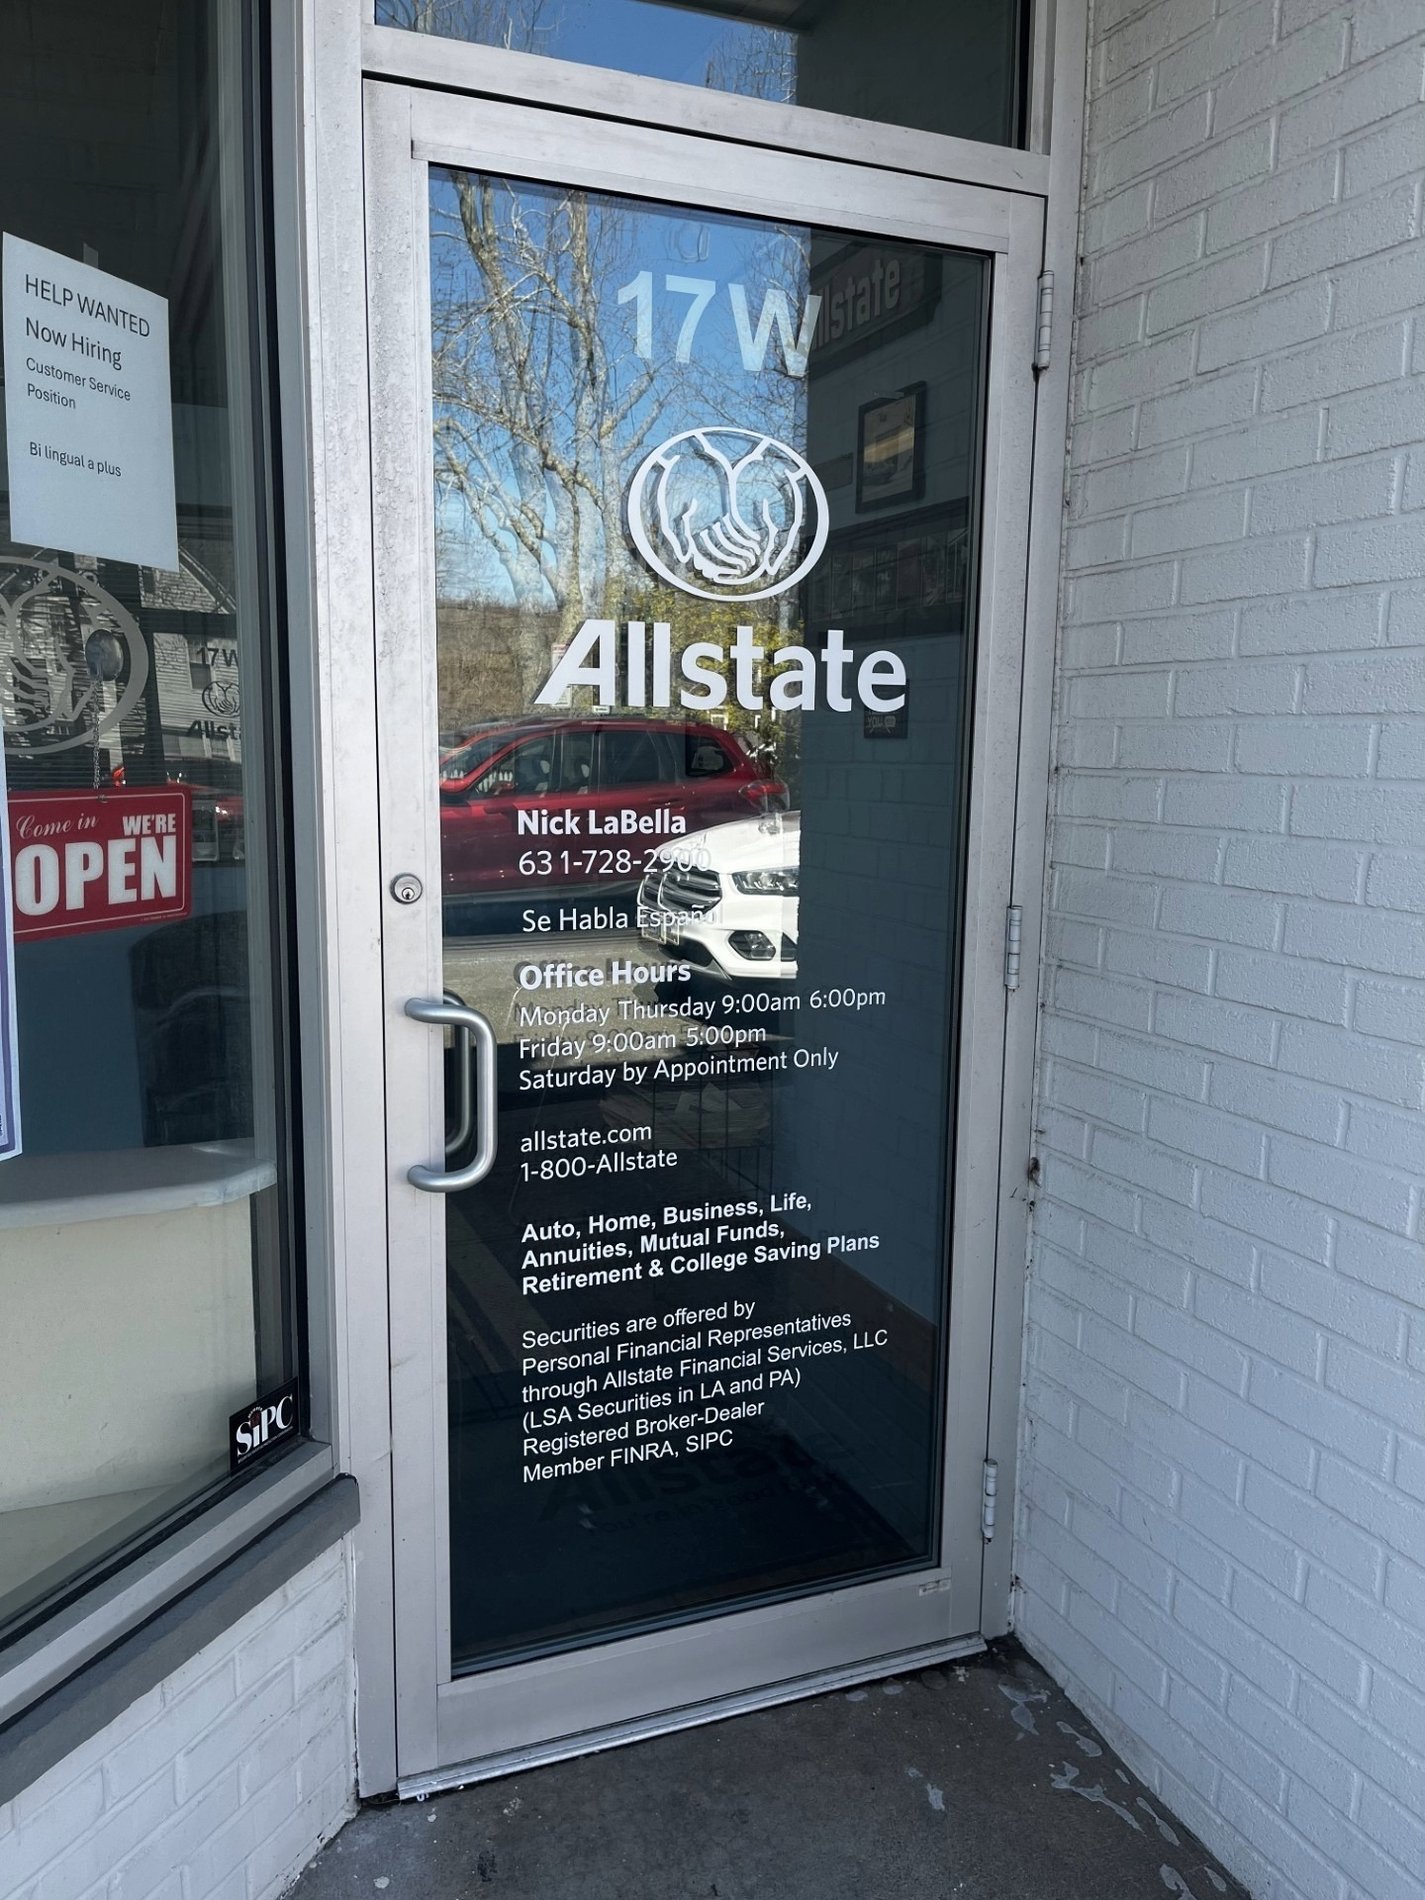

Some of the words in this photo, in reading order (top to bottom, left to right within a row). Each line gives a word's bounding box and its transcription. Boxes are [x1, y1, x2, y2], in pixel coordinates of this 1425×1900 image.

[25, 273, 73, 307] HELP
[77, 292, 150, 337] WANTED
[811, 259, 900, 350] llstate
[26, 317, 67, 347] Now
[72, 333, 122, 371] Hiring
[26, 357, 86, 387] Customer
[89, 377, 131, 401] Service
[27, 383, 76, 409] Position
[87, 460, 94, 470] a
[97, 461, 122, 475] plus
[534, 619, 907, 712] Allstate
[16, 815, 72, 839] Come
[77, 813, 99, 830] in
[123, 813, 176, 836] WE'RE
[517, 810, 581, 835] Nick
[589, 808, 687, 835] LaBella
[15, 835, 177, 916] OPEN
[522, 909, 551, 932] Se
[559, 906, 628, 931] Habla
[519, 963, 605, 990] Office
[612, 960, 691, 984] Hours
[520, 1005, 610, 1028] Monday
[619, 998, 716, 1022] Thursday
[722, 993, 800, 1014] 9:00am
[810, 989, 886, 1011] 6:00pm
[520, 1036, 585, 1059] Friday
[592, 1031, 676, 1053] 9:00am
[686, 1025, 766, 1047] 5:00pm
[519, 1066, 616, 1090] Saturday
[623, 1062, 647, 1085] by
[654, 1051, 787, 1081] Appointment
[794, 1047, 839, 1070] Only
[520, 1124, 652, 1152] allstate.com
[521, 1149, 678, 1182] 1-800-Allstate
[521, 1222, 581, 1243] Auto,
[588, 1213, 656, 1235] Home,
[663, 1199, 764, 1224] Business,
[770, 1192, 812, 1212] Life,
[521, 1241, 633, 1269] Annuities,
[640, 1232, 710, 1254] Mutual
[717, 1220, 785, 1244] Funds,
[522, 1264, 642, 1295] Retirement
[649, 1260, 664, 1278] &
[670, 1248, 748, 1275] College
[754, 1240, 821, 1264] Saving
[827, 1234, 880, 1254] Plans
[522, 1320, 620, 1349] Securities
[626, 1315, 657, 1333] are
[663, 1302, 728, 1328] offered
[734, 1300, 756, 1320] by
[522, 1346, 610, 1376] Personal
[617, 1332, 701, 1361] Financial
[708, 1313, 852, 1347] Representatives
[522, 1375, 597, 1403] through
[603, 1366, 673, 1389] Allstate
[680, 1348, 761, 1377] Financial
[768, 1338, 847, 1363] Services,
[853, 1330, 888, 1350] LLC
[523, 1406, 572, 1433] (LSA
[577, 1391, 672, 1420] Securities
[678, 1385, 694, 1403] in
[700, 1379, 725, 1399] LA
[730, 1374, 763, 1394] and
[769, 1367, 801, 1388] PA)
[523, 1423, 629, 1456] Registered
[636, 1400, 765, 1436] Broker-Dealer
[523, 1457, 604, 1483] Member
[611, 1442, 679, 1467] FINRA,
[686, 1429, 733, 1452] SIPC
